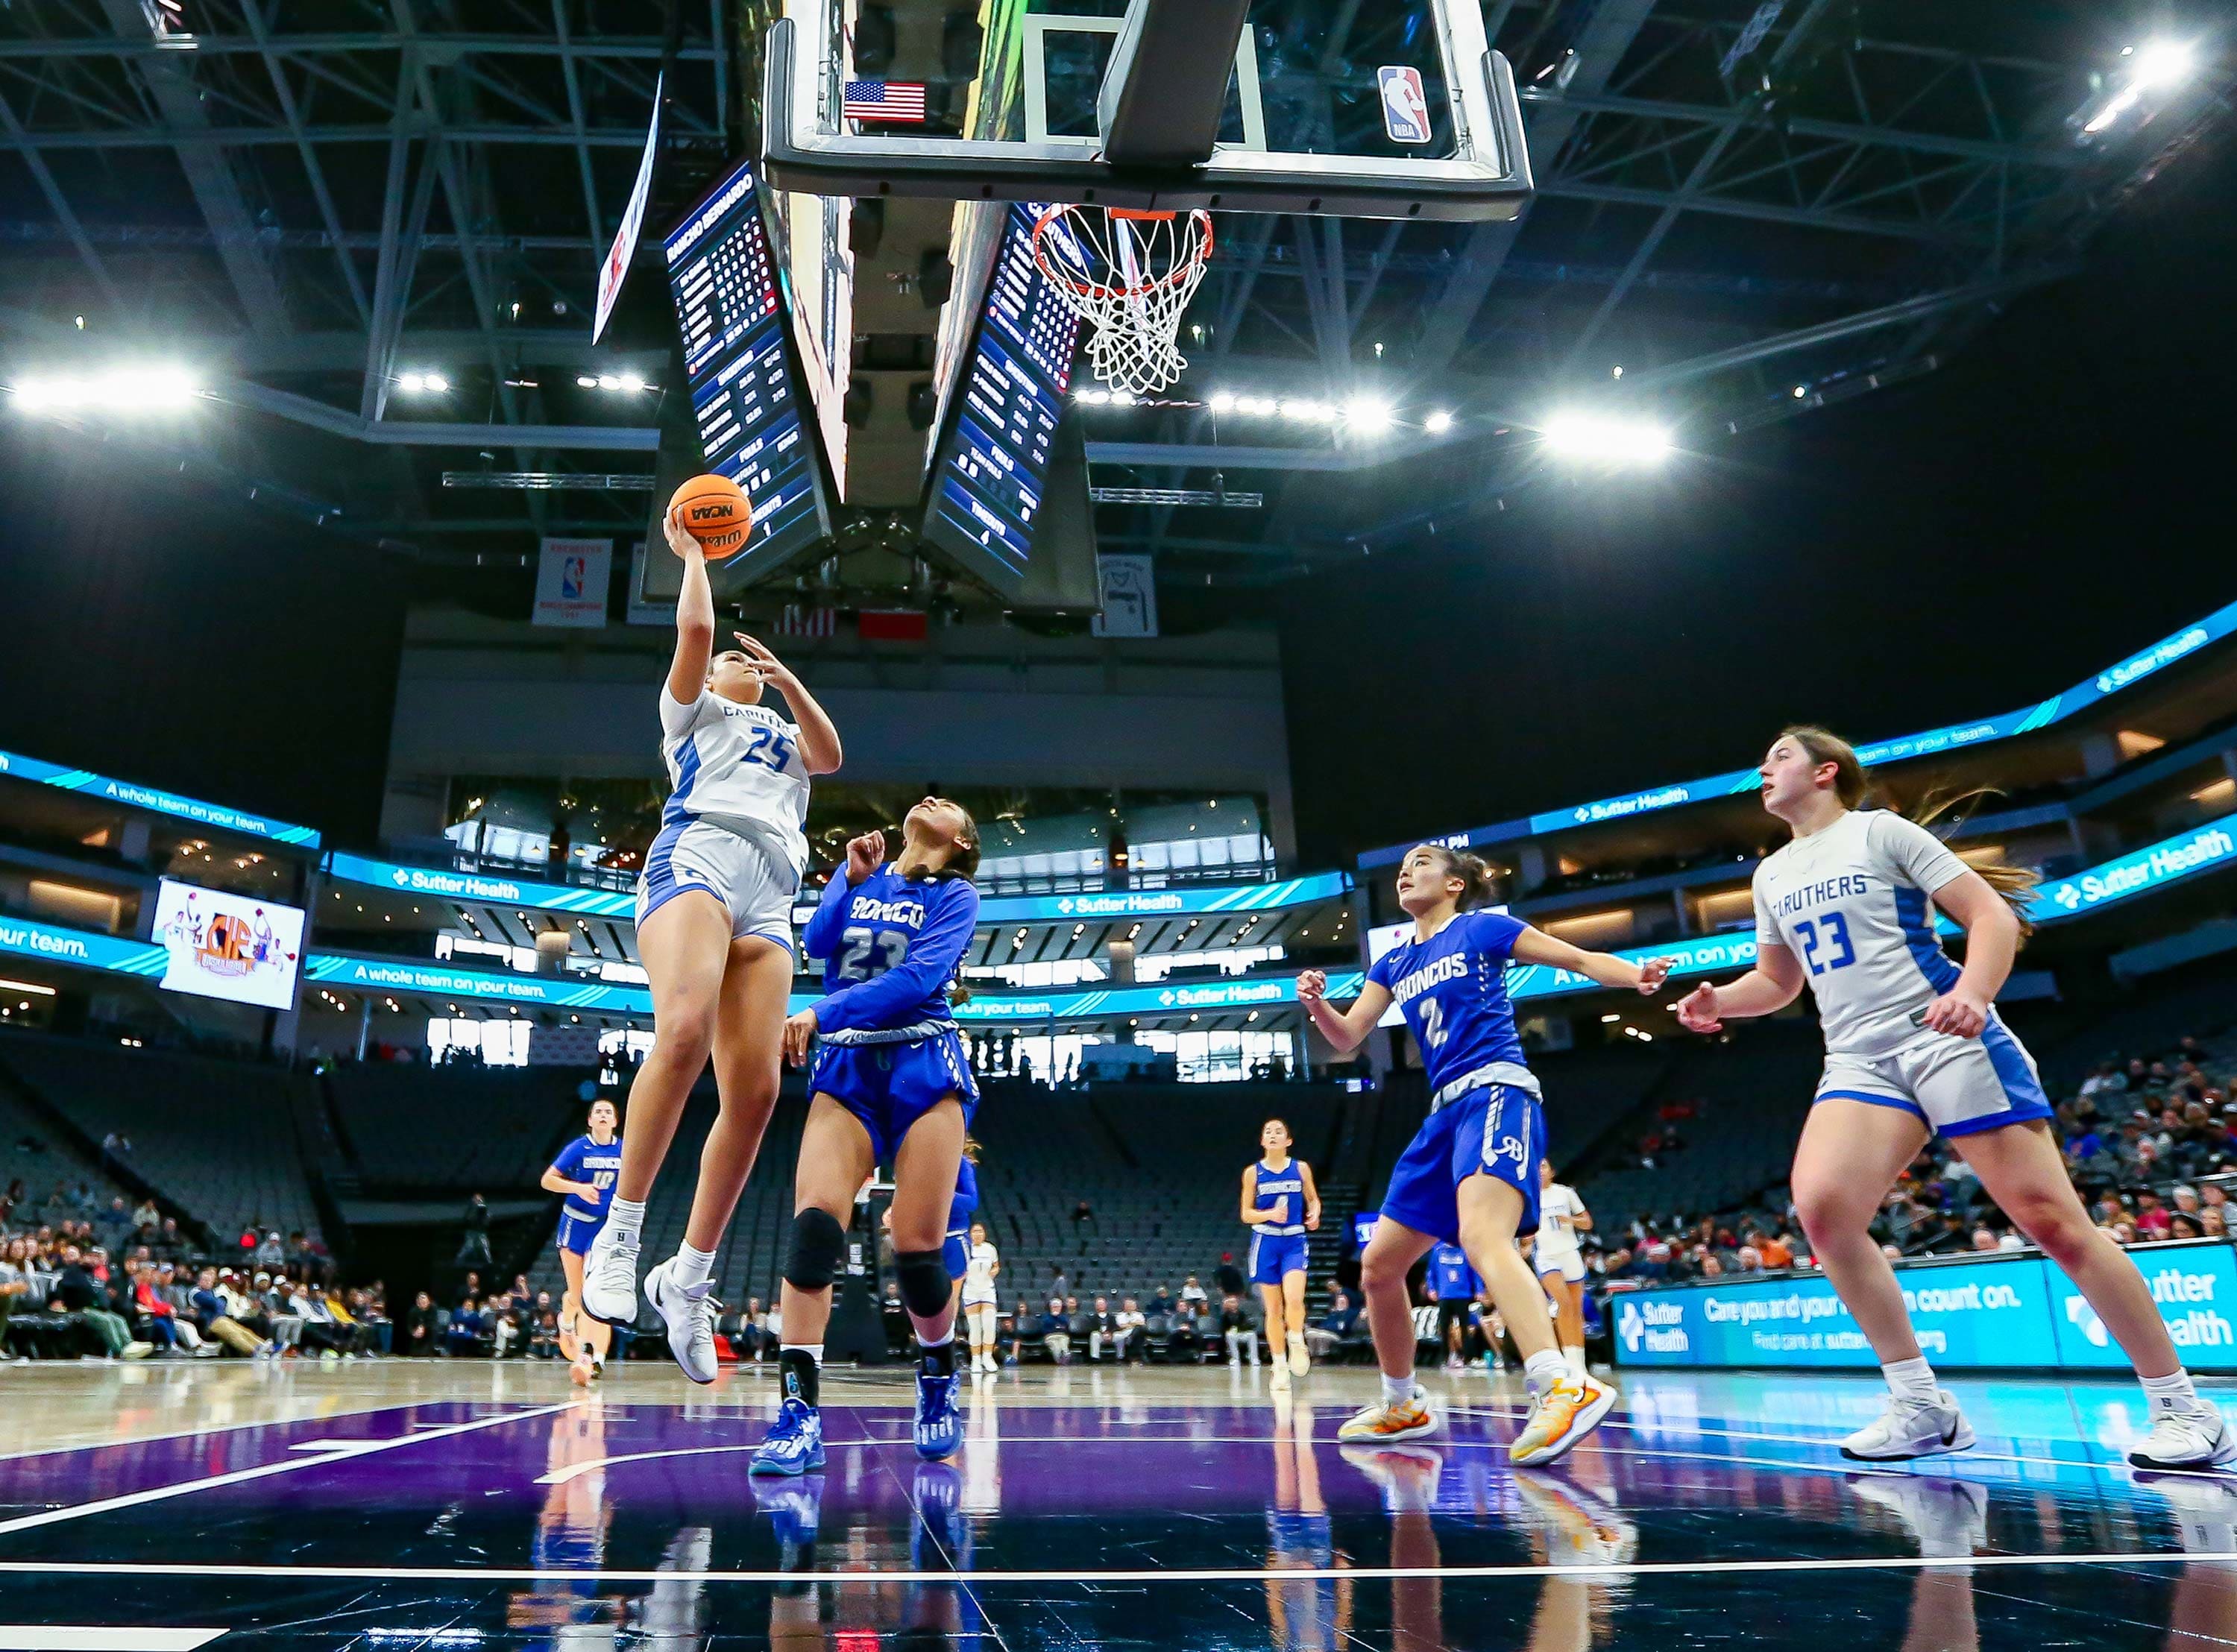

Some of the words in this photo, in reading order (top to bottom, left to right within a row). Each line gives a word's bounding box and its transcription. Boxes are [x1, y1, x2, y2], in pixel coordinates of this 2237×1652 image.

[1393, 123, 1415, 136] NBA
[666, 220, 702, 263] RANCHO
[702, 173, 752, 229] BERNARDO
[739, 438, 763, 462] FOULS
[970, 447, 987, 465] TEAM
[991, 445, 1013, 471] FOULS
[692, 505, 733, 520] NCAA
[763, 521, 770, 536] 1
[980, 530, 989, 544] 4
[2110, 655, 2157, 687] Sutter
[2159, 628, 2210, 665] Health
[740, 726, 795, 772] 25
[1858, 748, 1890, 762] eam
[1916, 737, 1949, 754] your
[1951, 725, 1998, 743] team.
[106, 782, 118, 797] A
[119, 786, 157, 807] whole
[159, 795, 189, 813] team
[190, 804, 207, 817] on
[207, 808, 234, 828] your
[235, 811, 268, 833] team.
[1591, 799, 1637, 821] Sutter
[1638, 787, 1689, 813] Health
[1447, 833, 1470, 850] PM
[2080, 858, 2149, 904] Sutter
[2149, 828, 2235, 879] Health
[411, 872, 463, 893] Sutter
[465, 877, 520, 900] Health
[1076, 896, 1130, 914] Sutter
[1133, 893, 1183, 911] Health
[31, 930, 89, 959] team.
[207, 914, 252, 961] CIF
[1793, 911, 1857, 977] 23
[837, 926, 909, 982] 23
[1554, 969, 1571, 986] A
[1696, 946, 1725, 965] on
[1728, 940, 1758, 964] yo
[354, 965, 366, 980] A
[368, 968, 413, 986] whole
[415, 971, 452, 988] team
[454, 976, 472, 990] on
[473, 979, 505, 995] your
[507, 980, 546, 998] team.
[1175, 988, 1231, 1006] Sutter
[1234, 983, 1282, 1002] Health
[984, 1003, 1014, 1017] your
[1015, 1002, 1054, 1015] team.
[1419, 996, 1449, 1049] 2
[2144, 1267, 2217, 1303] utter
[1642, 1301, 1684, 1325] Sutter
[1704, 1296, 1740, 1323] Care
[1741, 1299, 1767, 1326] you
[1769, 1294, 1800, 1320] and
[1917, 1283, 1982, 1311] count
[1983, 1284, 2022, 1308] on.
[1645, 1328, 1690, 1352] Health
[1752, 1330, 1780, 1350] Find
[1781, 1333, 1809, 1351] care
[2163, 1308, 2234, 1346] alth
